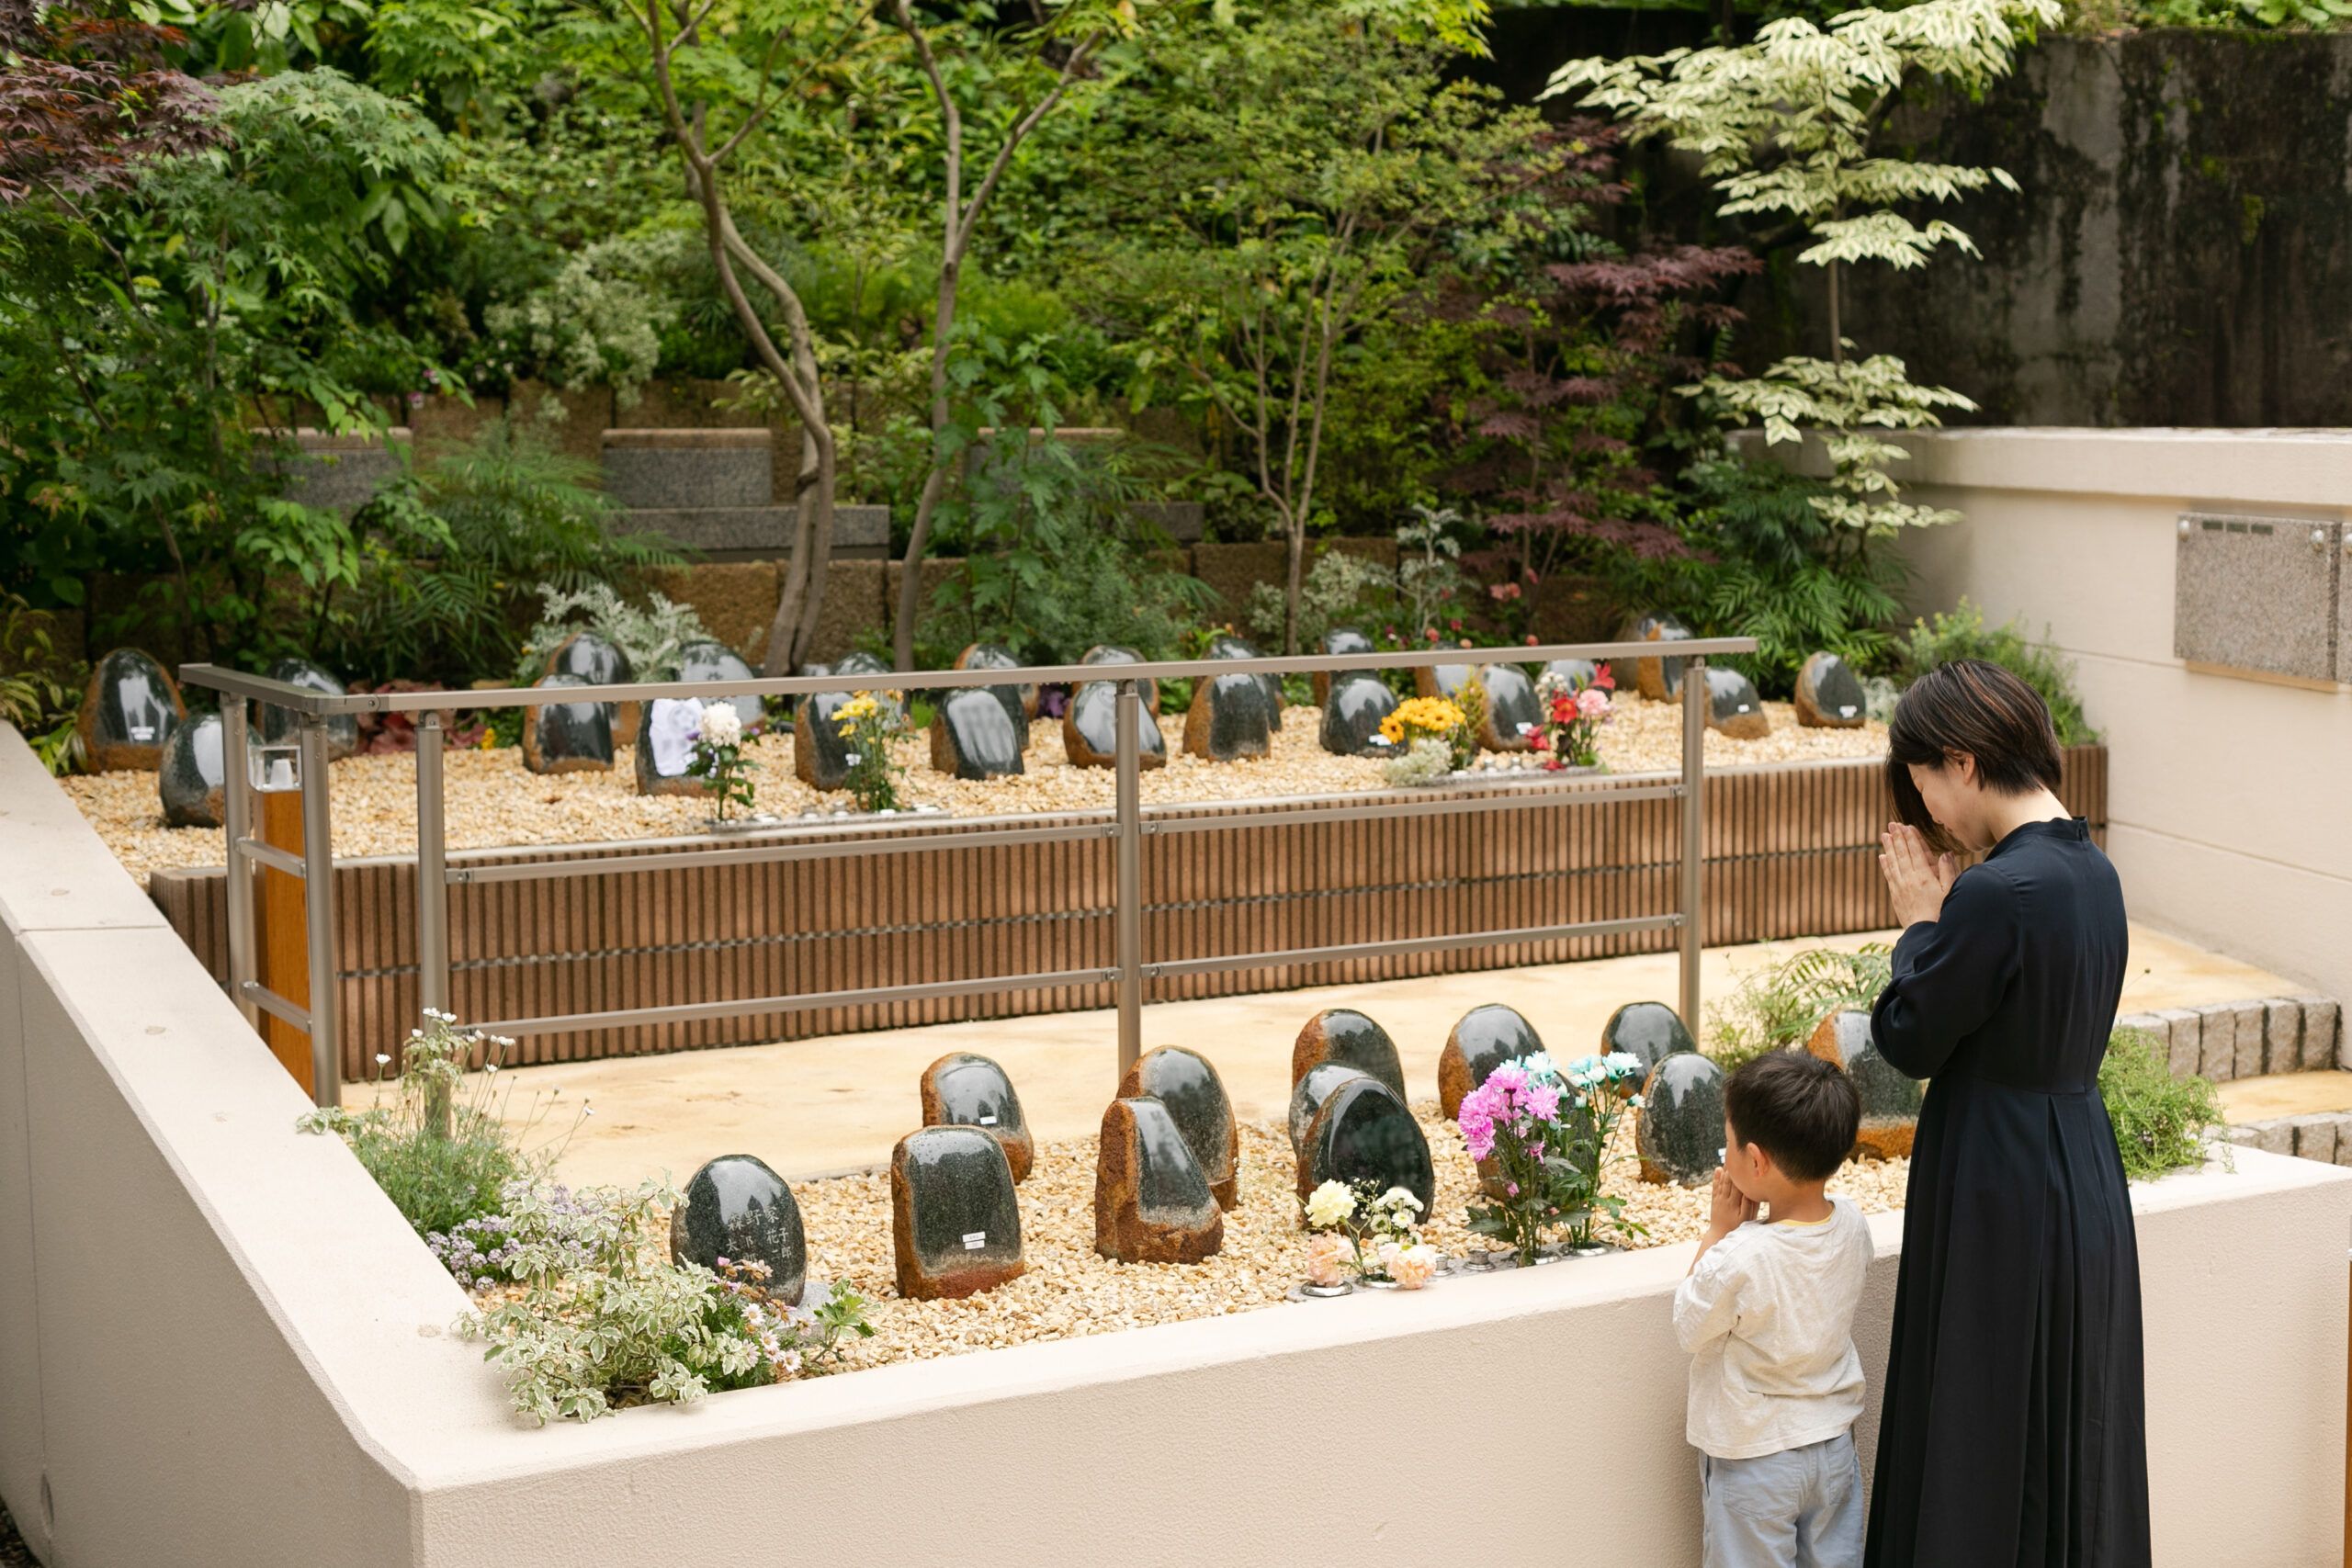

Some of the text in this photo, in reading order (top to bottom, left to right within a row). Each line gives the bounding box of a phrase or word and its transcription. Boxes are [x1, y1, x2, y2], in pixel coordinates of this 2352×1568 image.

[728, 1206, 779, 1231] 森野家
[766, 1227, 789, 1244] 花子
